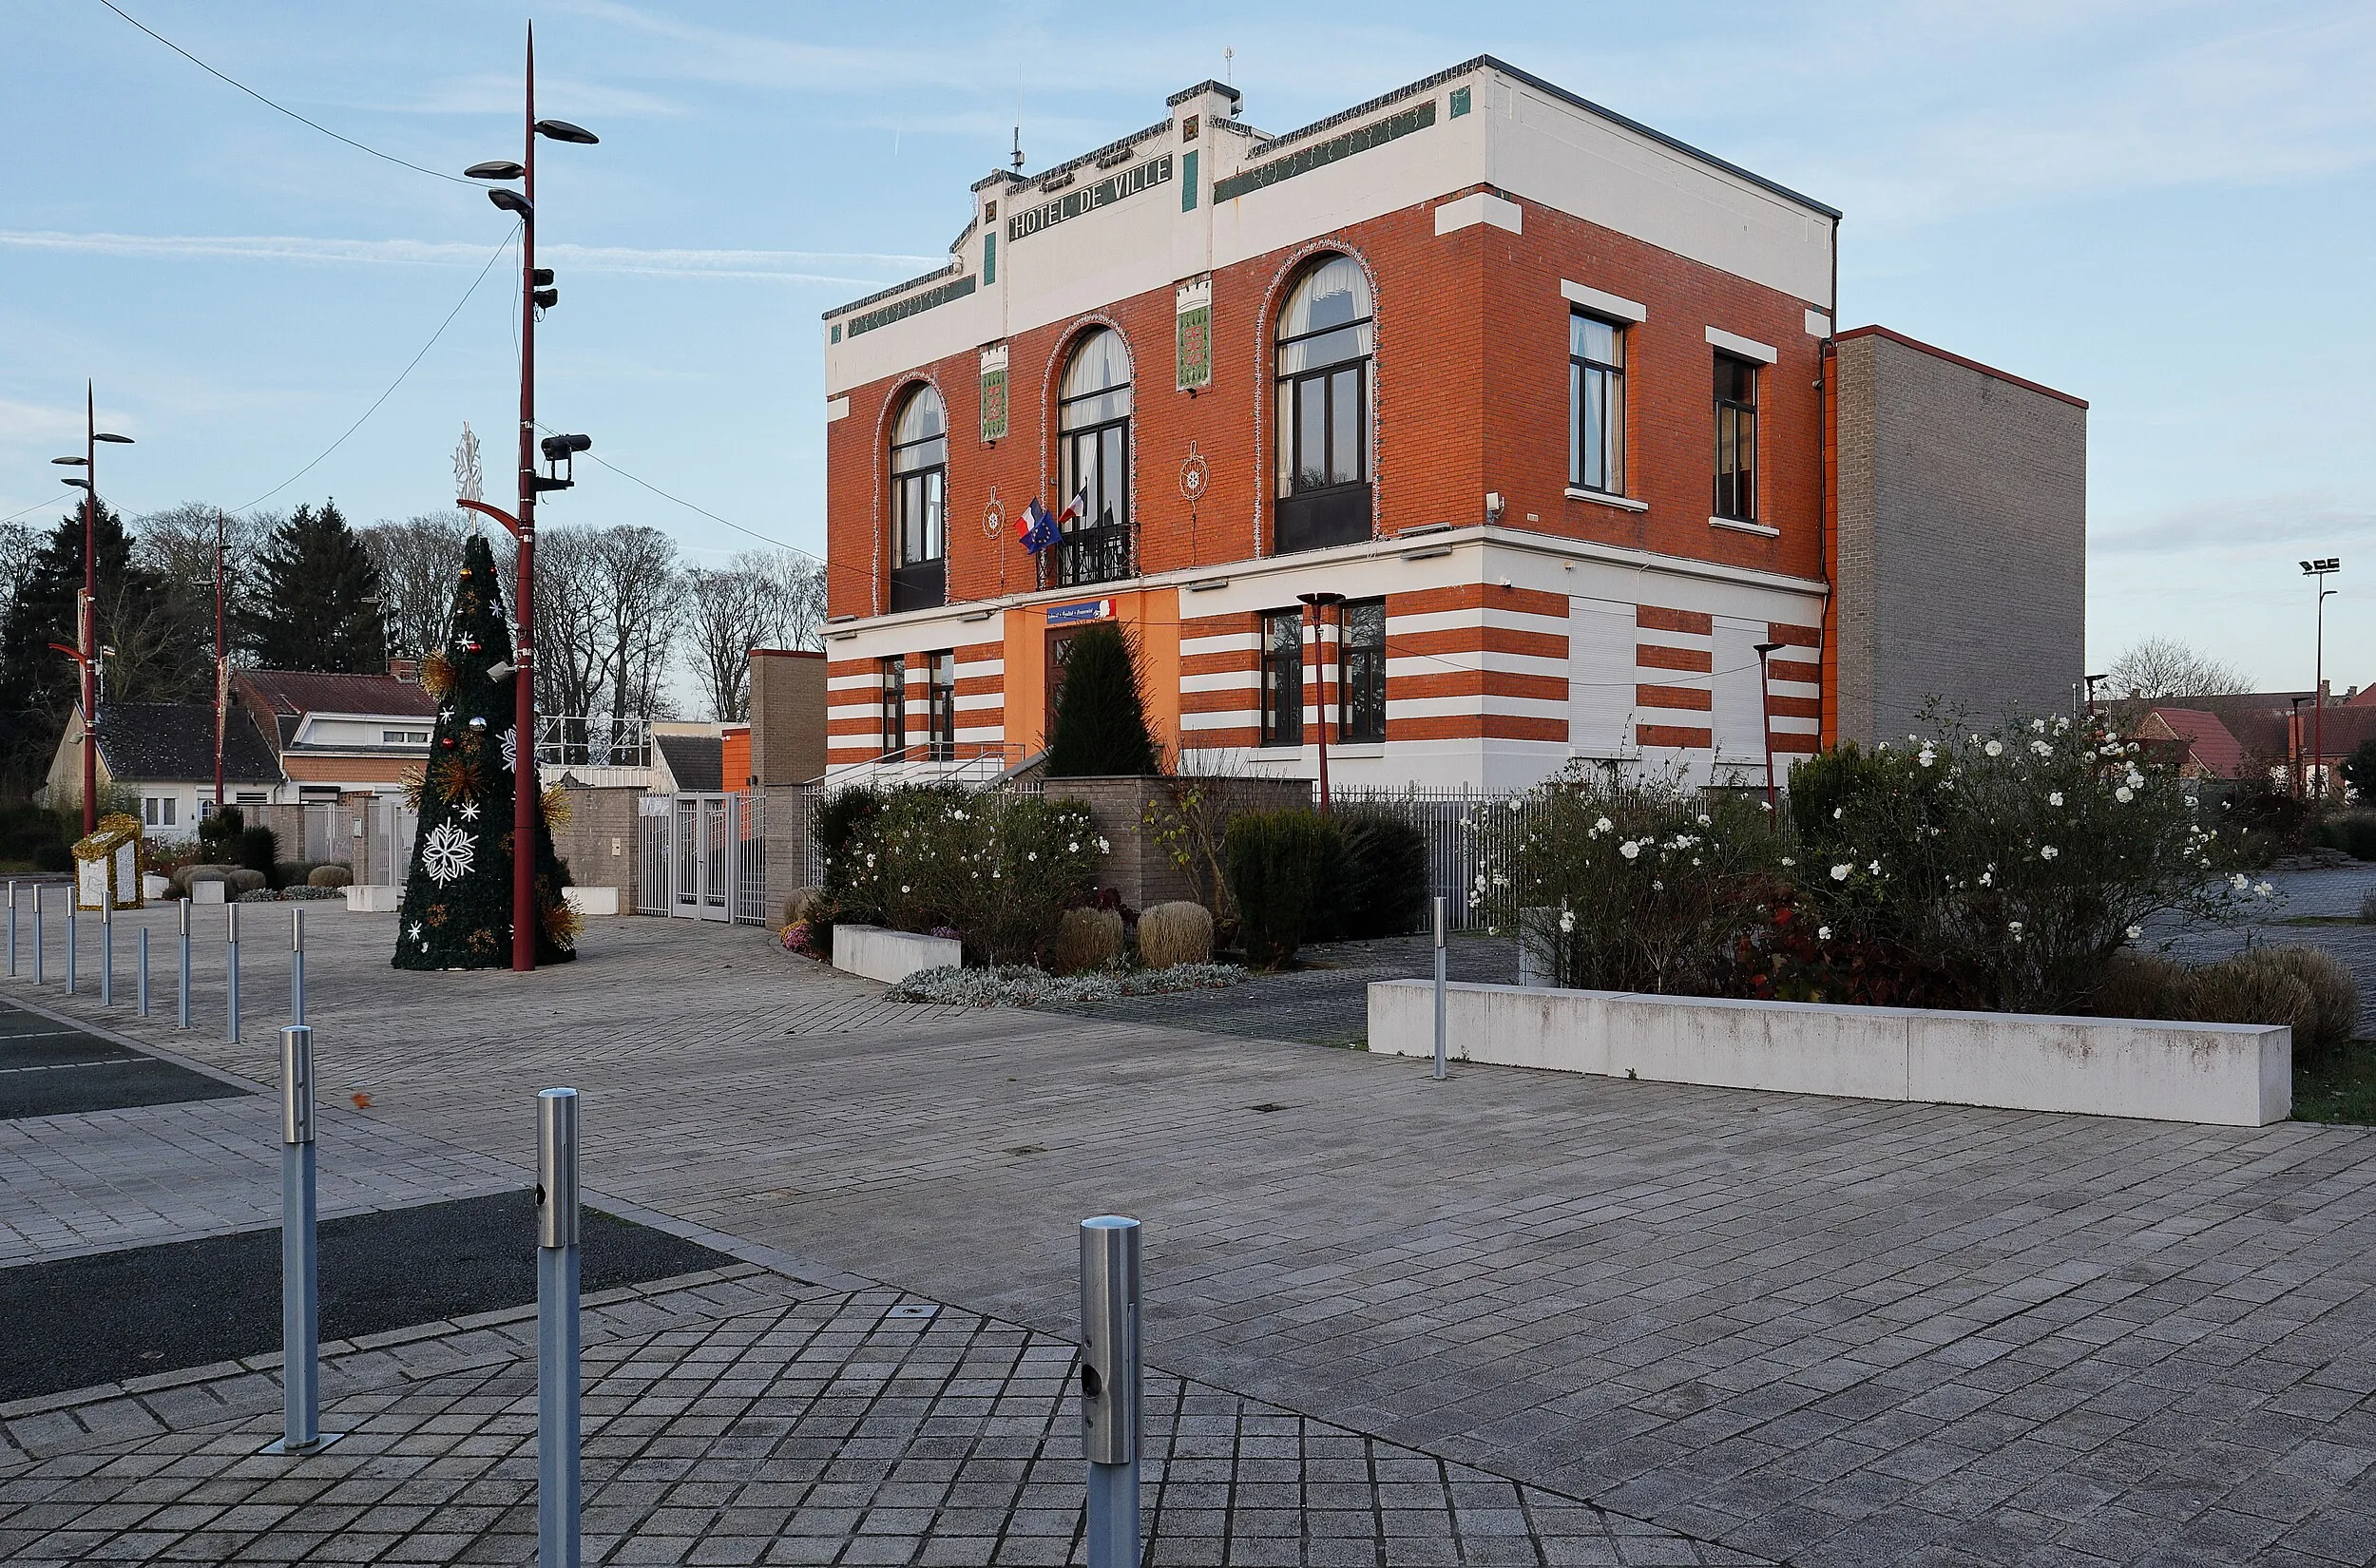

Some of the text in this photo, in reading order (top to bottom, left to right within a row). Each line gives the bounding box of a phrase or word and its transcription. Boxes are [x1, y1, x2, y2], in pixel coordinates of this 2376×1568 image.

[1014, 158, 1169, 239] HOTEL DE VILLE
